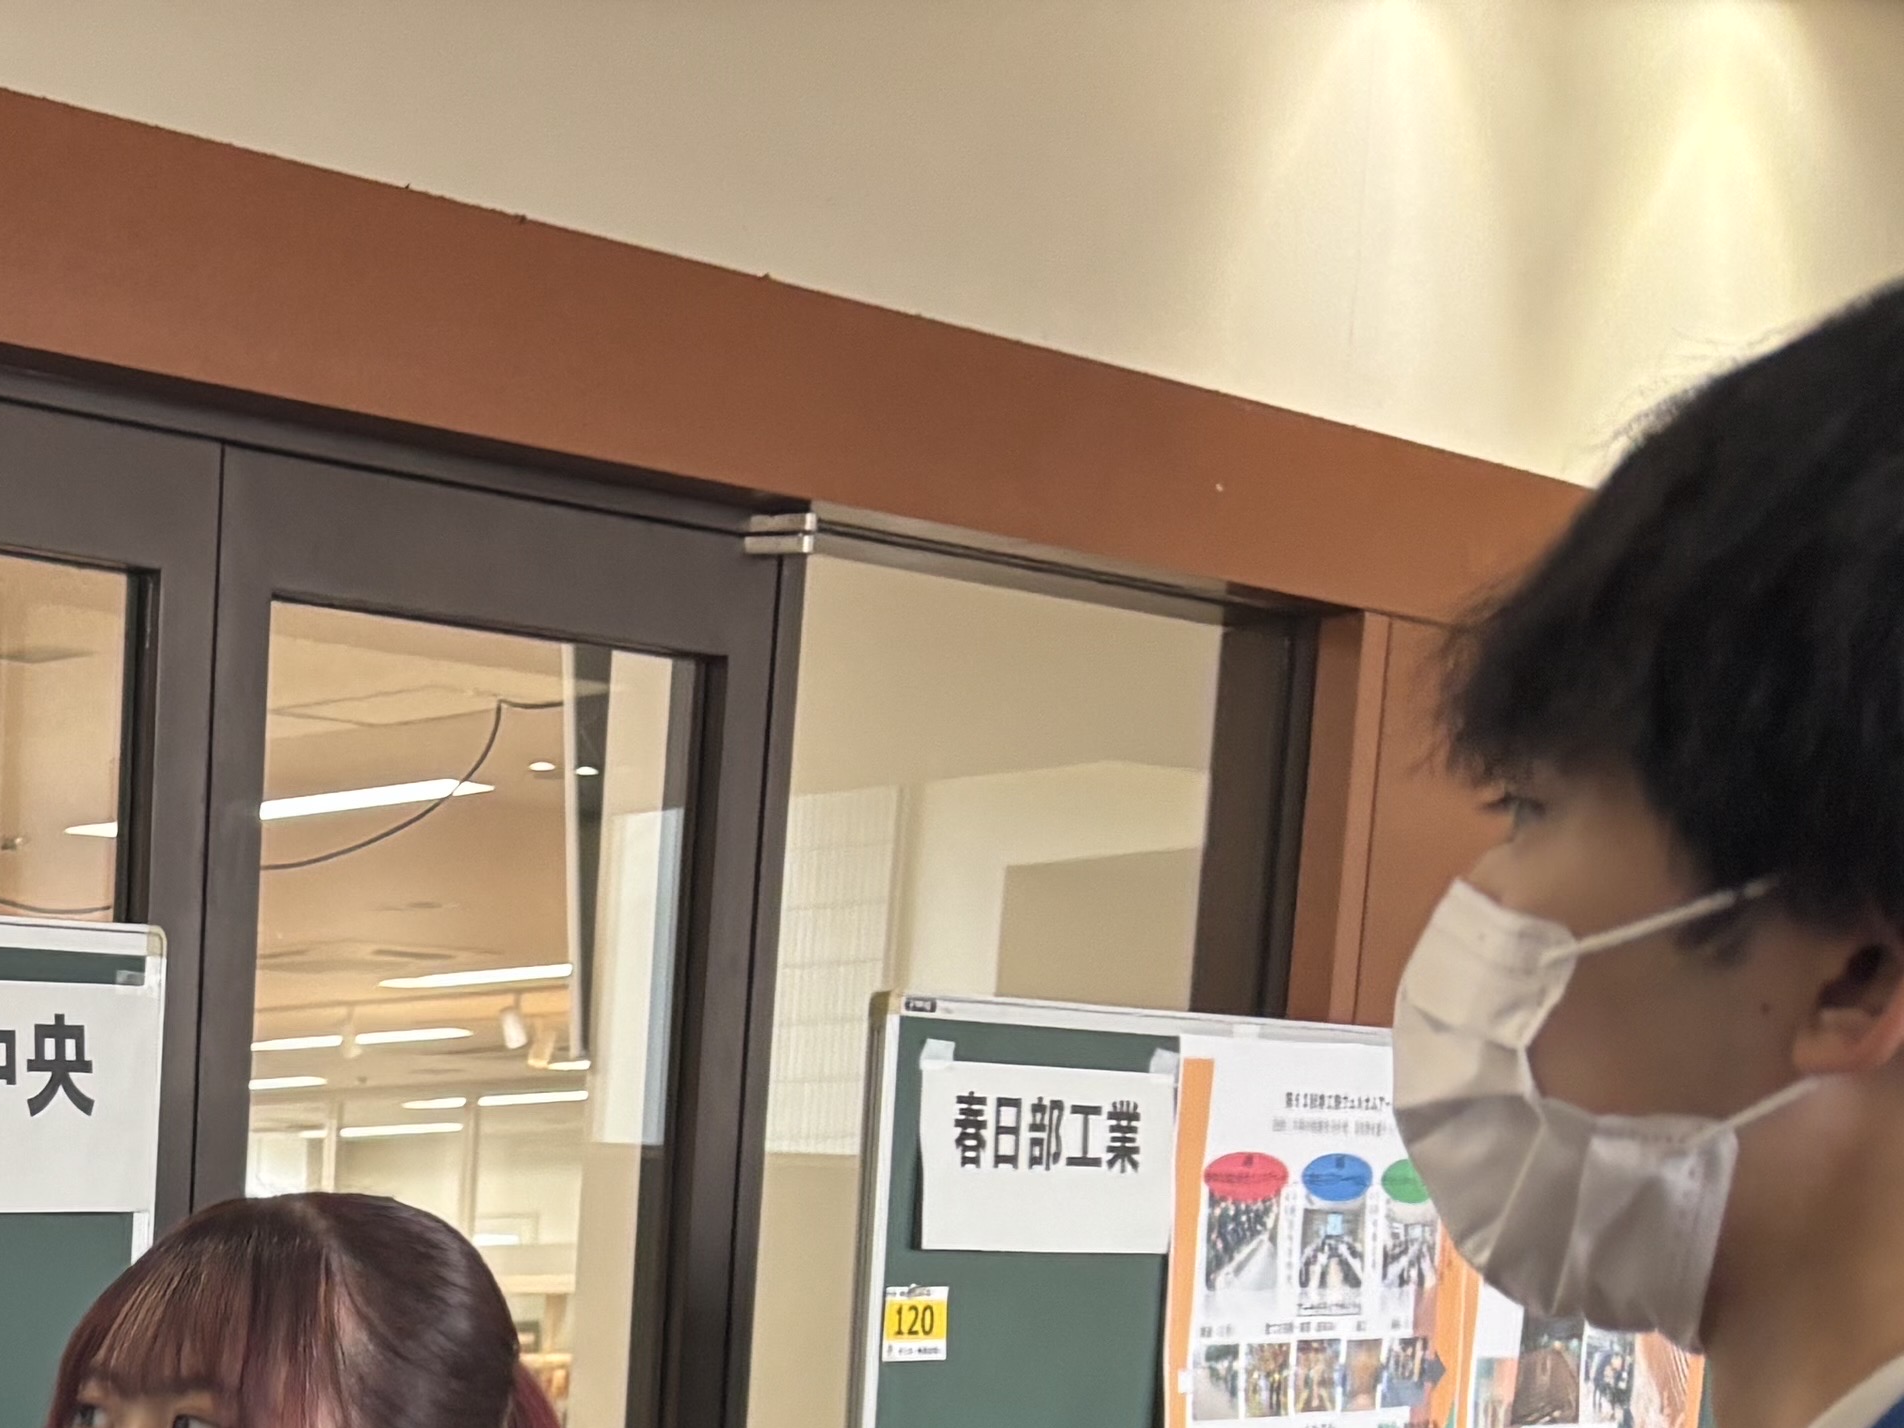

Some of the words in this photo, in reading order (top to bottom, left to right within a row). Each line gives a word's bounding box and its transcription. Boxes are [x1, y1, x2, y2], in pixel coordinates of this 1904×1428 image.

[954, 1091, 1140, 1173] 春日部工業
[892, 1305, 934, 1335] 120
